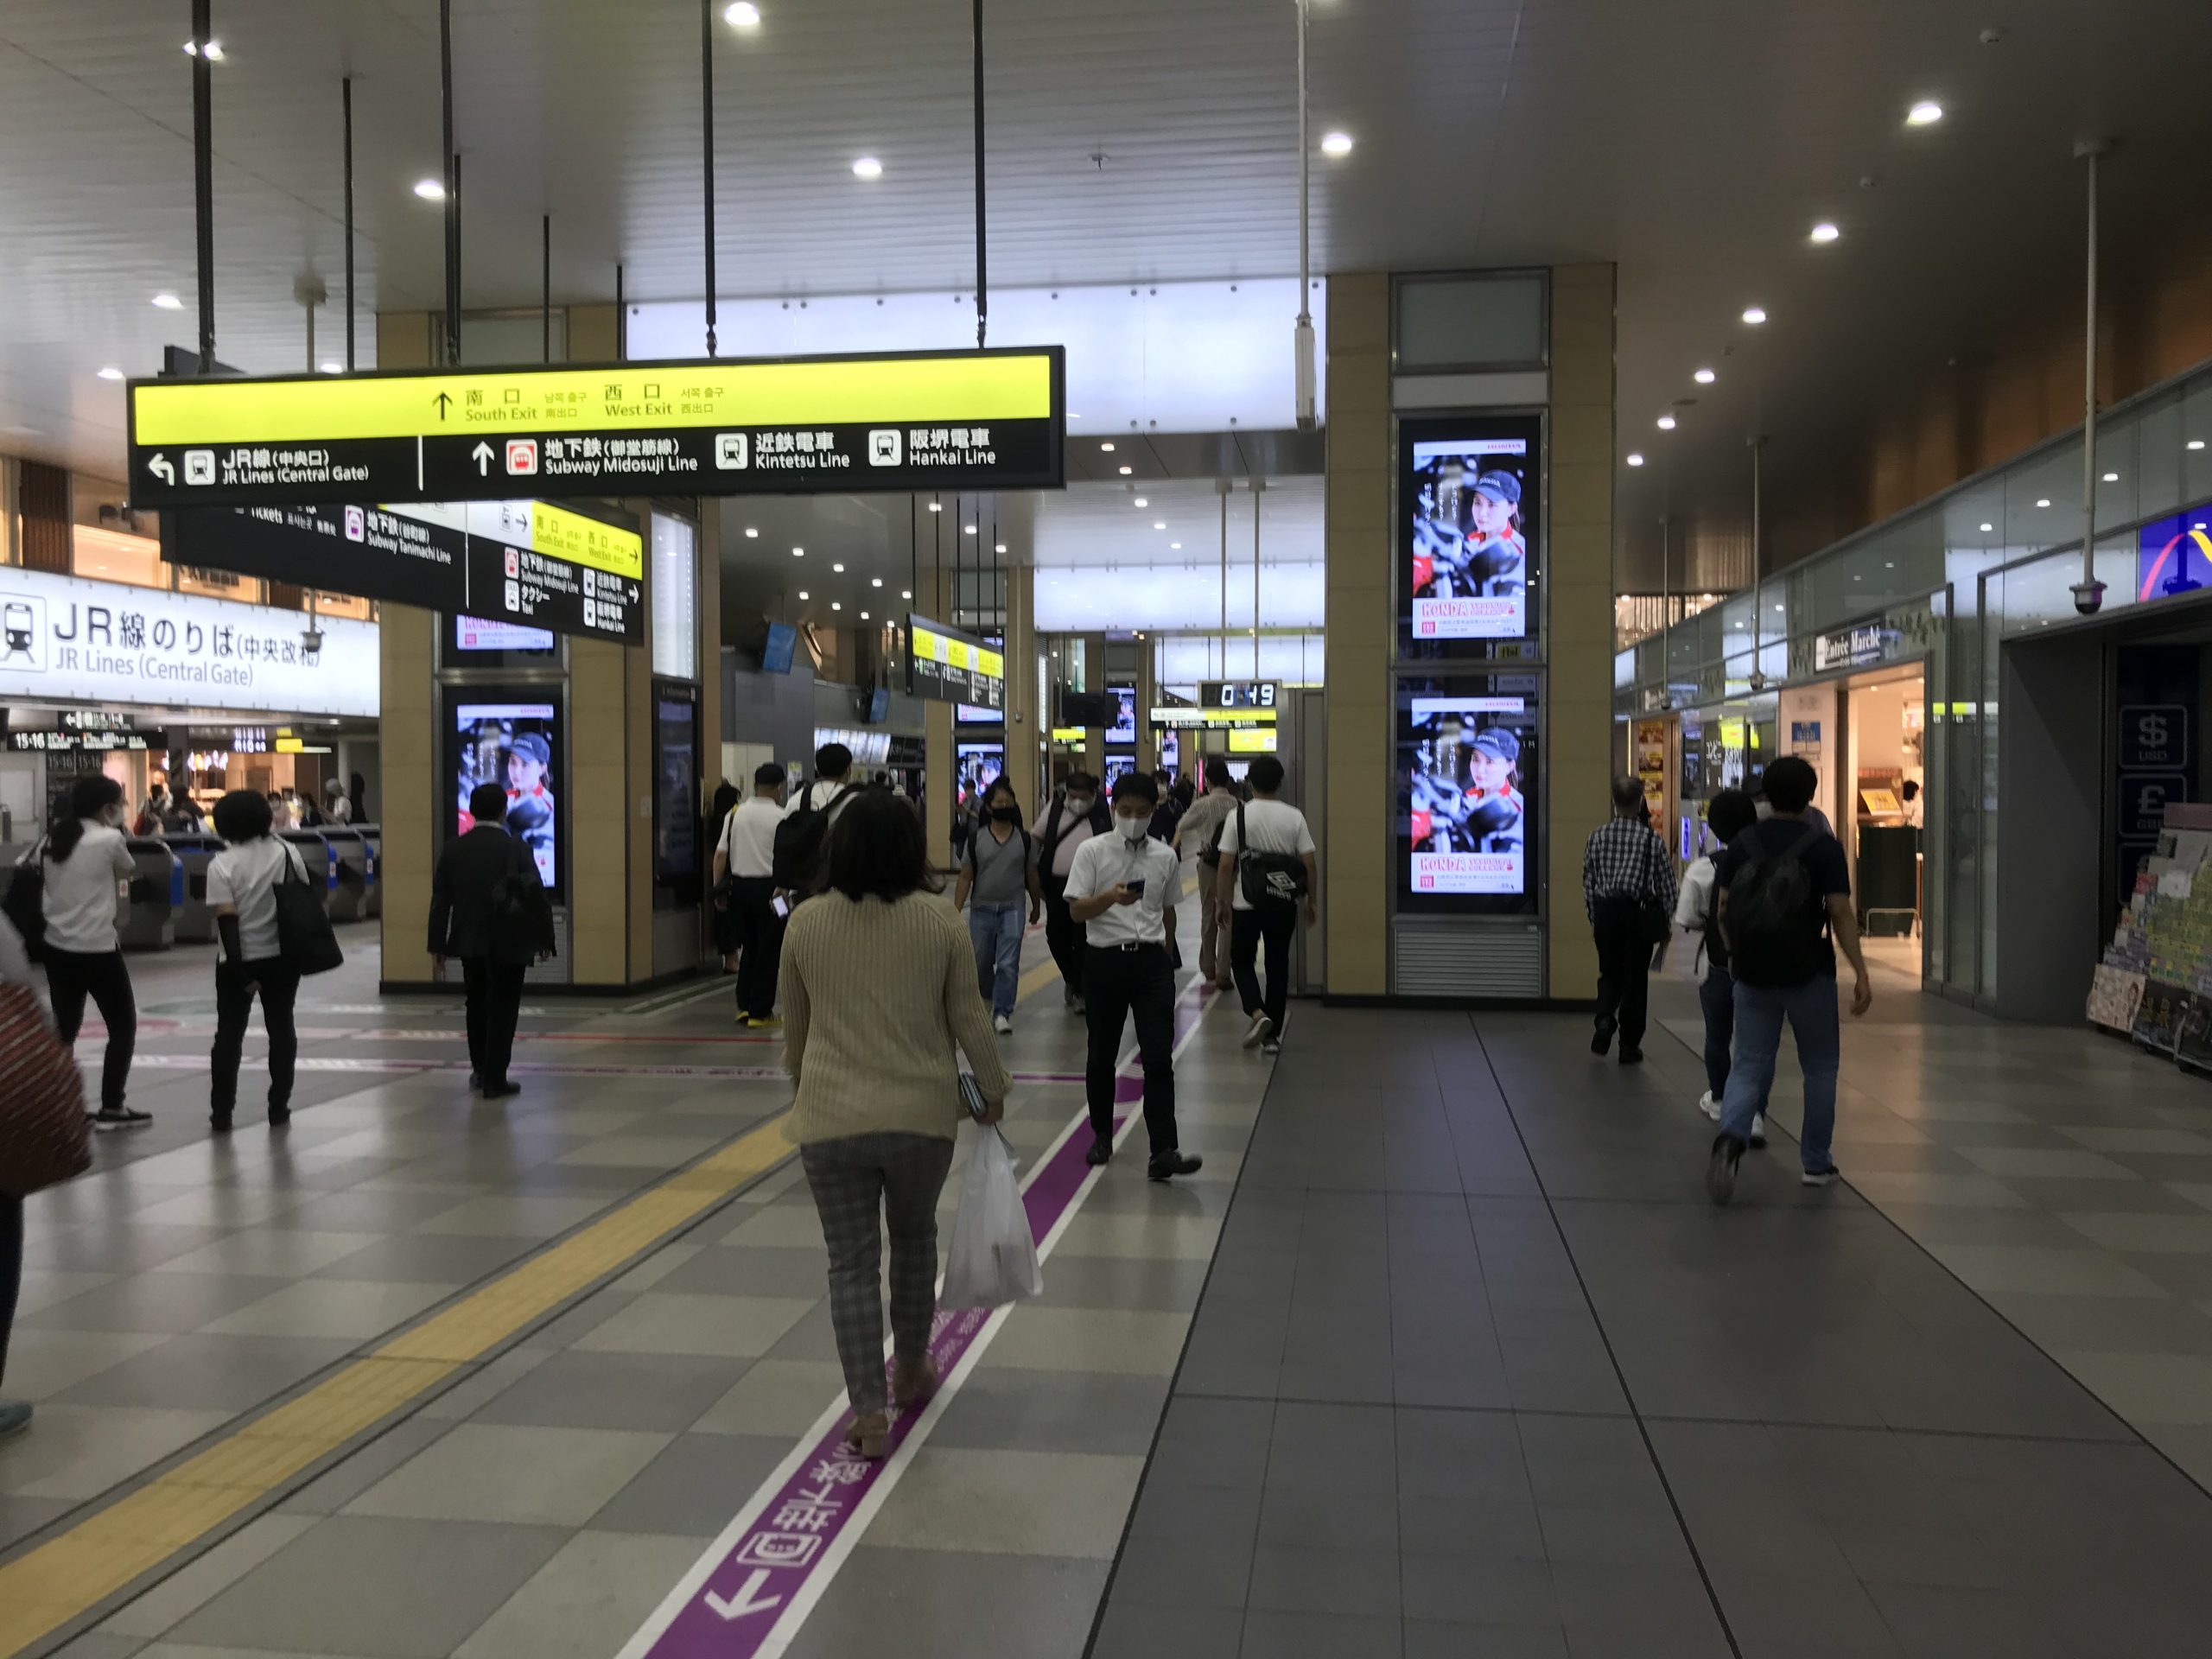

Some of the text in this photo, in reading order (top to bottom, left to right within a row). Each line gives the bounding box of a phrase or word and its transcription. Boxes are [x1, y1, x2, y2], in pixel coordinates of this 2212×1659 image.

[465, 405, 538, 422] South Exit
[605, 401, 673, 418] West Exit
[755, 431, 836, 454] 近鉄電車
[910, 428, 990, 450] 阪堺電車
[544, 454, 698, 476] Subway Midosuji Line
[755, 449, 850, 469] Kintetsu Line
[910, 448, 996, 467] Hankai Line
[222, 463, 369, 485] JR Lines (Central Gate)
[366, 532, 453, 565] Subway Tanimachi Line
[1422, 601, 1467, 617] HONDA
[1851, 625, 1881, 654] Marché
[56, 645, 253, 688] JR Lines (Central Gate)
[1421, 856, 1466, 872] HONDA
